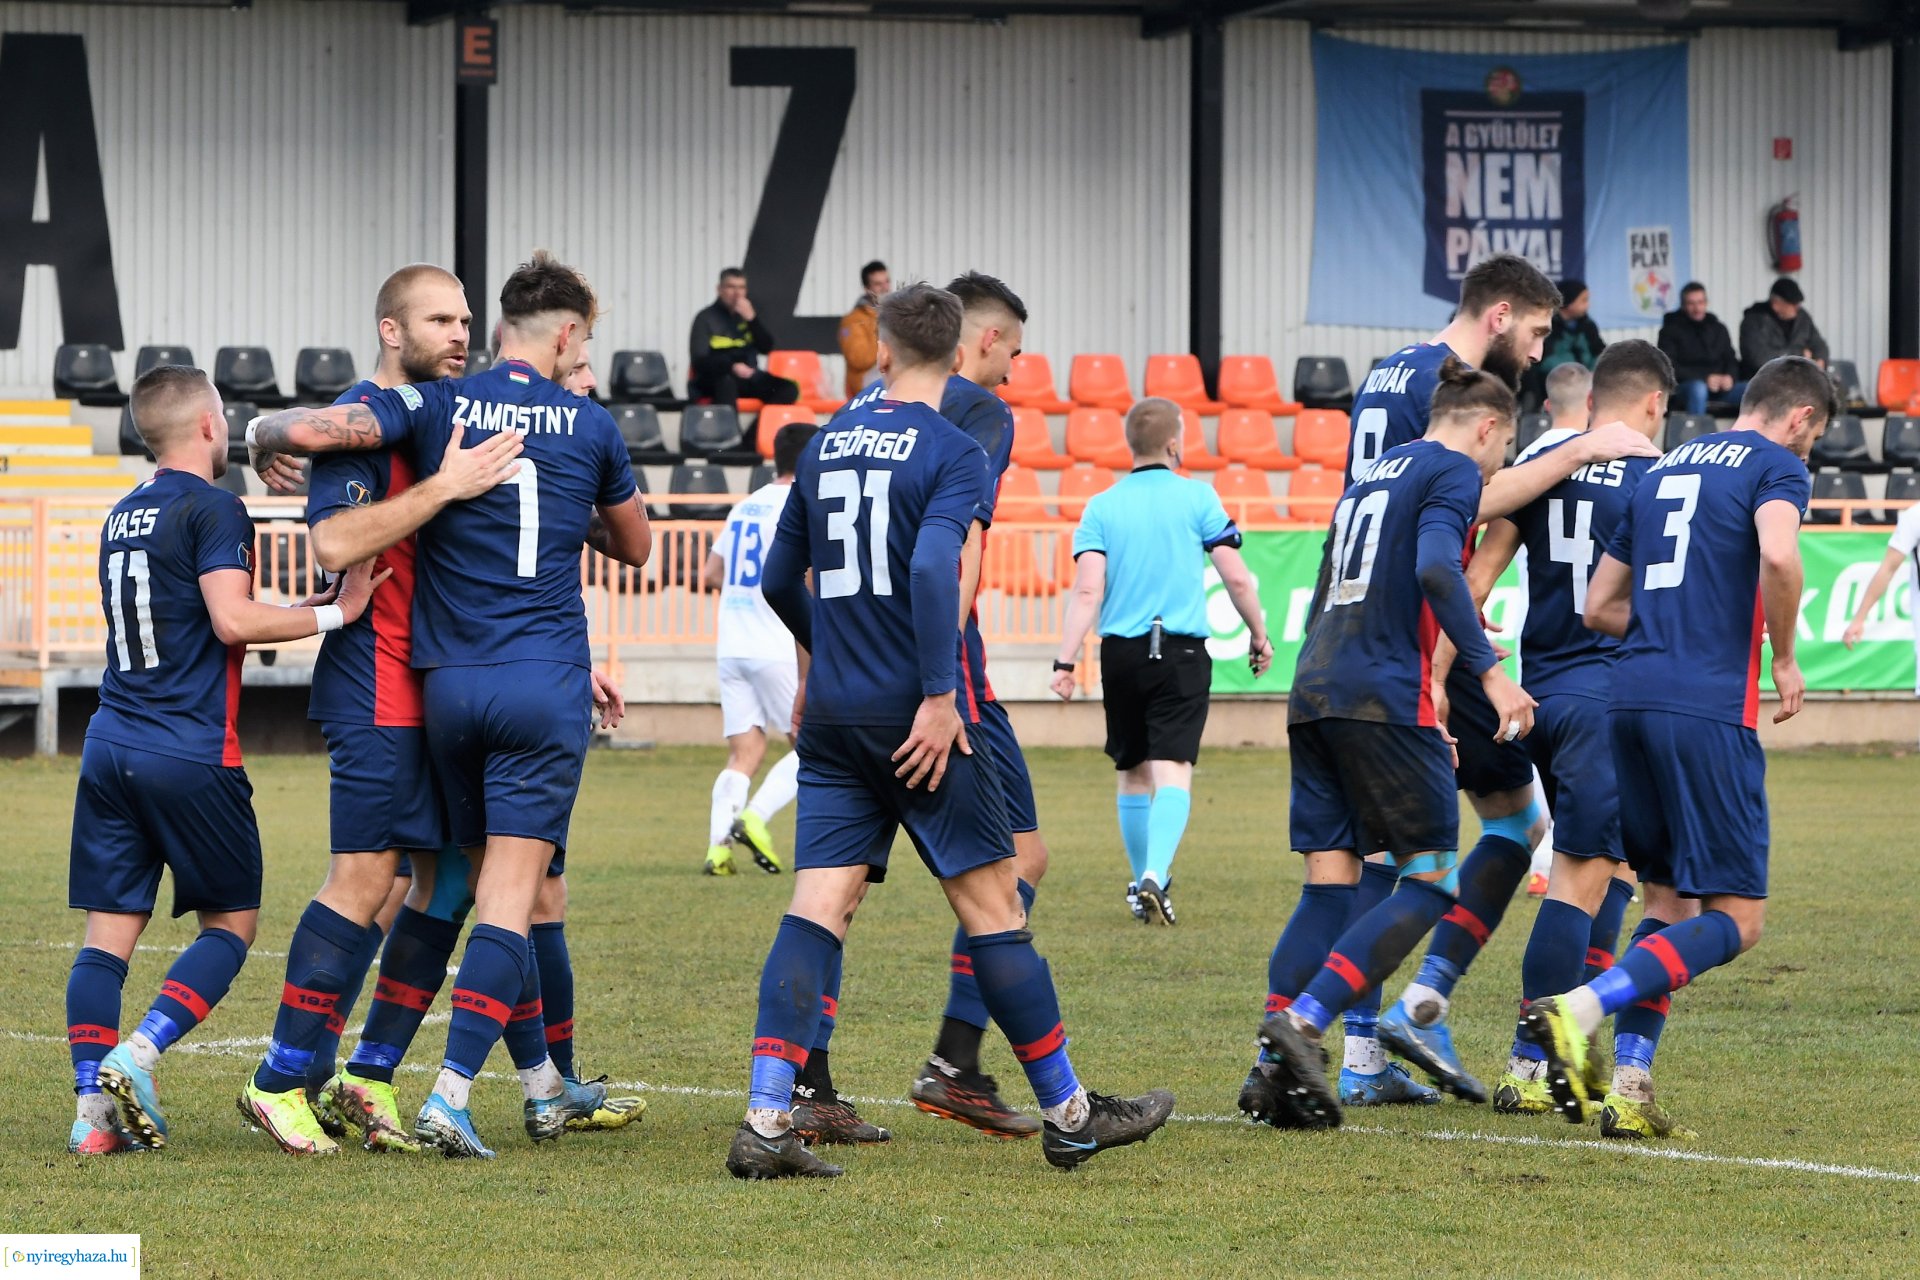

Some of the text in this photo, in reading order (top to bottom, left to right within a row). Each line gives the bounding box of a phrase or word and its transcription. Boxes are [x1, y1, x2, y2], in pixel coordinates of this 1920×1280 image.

[464, 26, 492, 64] E
[1445, 122, 1460, 147] A
[0, 33, 125, 350] A
[729, 46, 856, 354] Z
[1445, 151, 1562, 220] NEM
[1446, 220, 1562, 273] PÁLYA!
[1630, 231, 1669, 250] FAIR
[1630, 251, 1669, 268] PLAY
[452, 395, 578, 436] ZAMOSTNY
[107, 508, 160, 541] VASS
[729, 520, 763, 588] 13
[818, 469, 893, 599] 31
[1324, 489, 1390, 612] 10
[1548, 498, 1595, 615] 4
[1644, 473, 1701, 590] 3
[108, 549, 160, 672] 11
